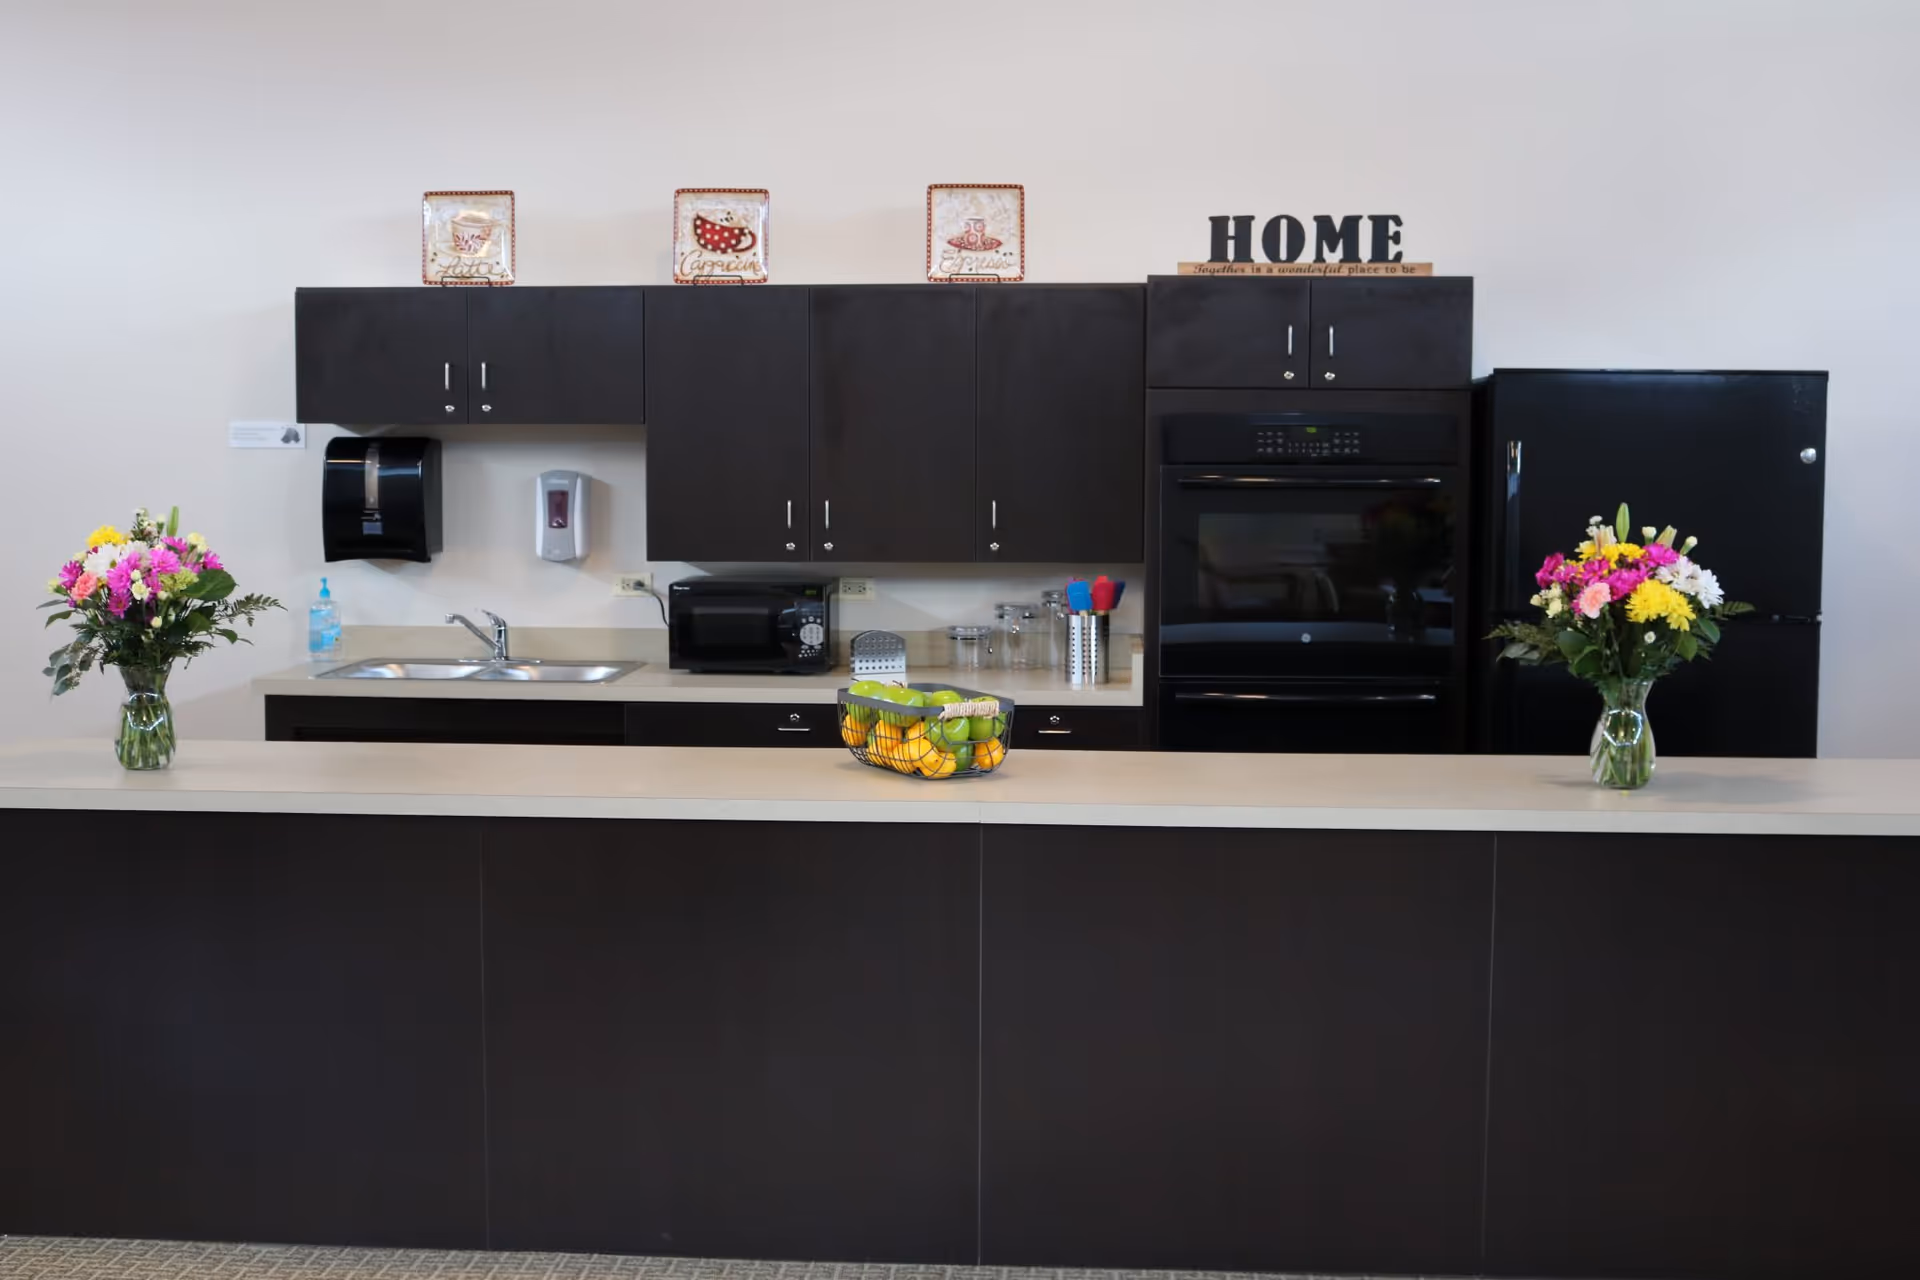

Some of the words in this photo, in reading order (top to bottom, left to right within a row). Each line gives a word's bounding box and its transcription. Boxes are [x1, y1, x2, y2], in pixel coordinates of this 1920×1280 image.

[1207, 214, 1403, 263] HOME
[1193, 264, 1245, 276] Together
[1251, 265, 1261, 273] is
[1278, 264, 1343, 277] wonderful
[1347, 264, 1380, 276] place
[1385, 265, 1397, 273] to
[1402, 264, 1416, 273] be
